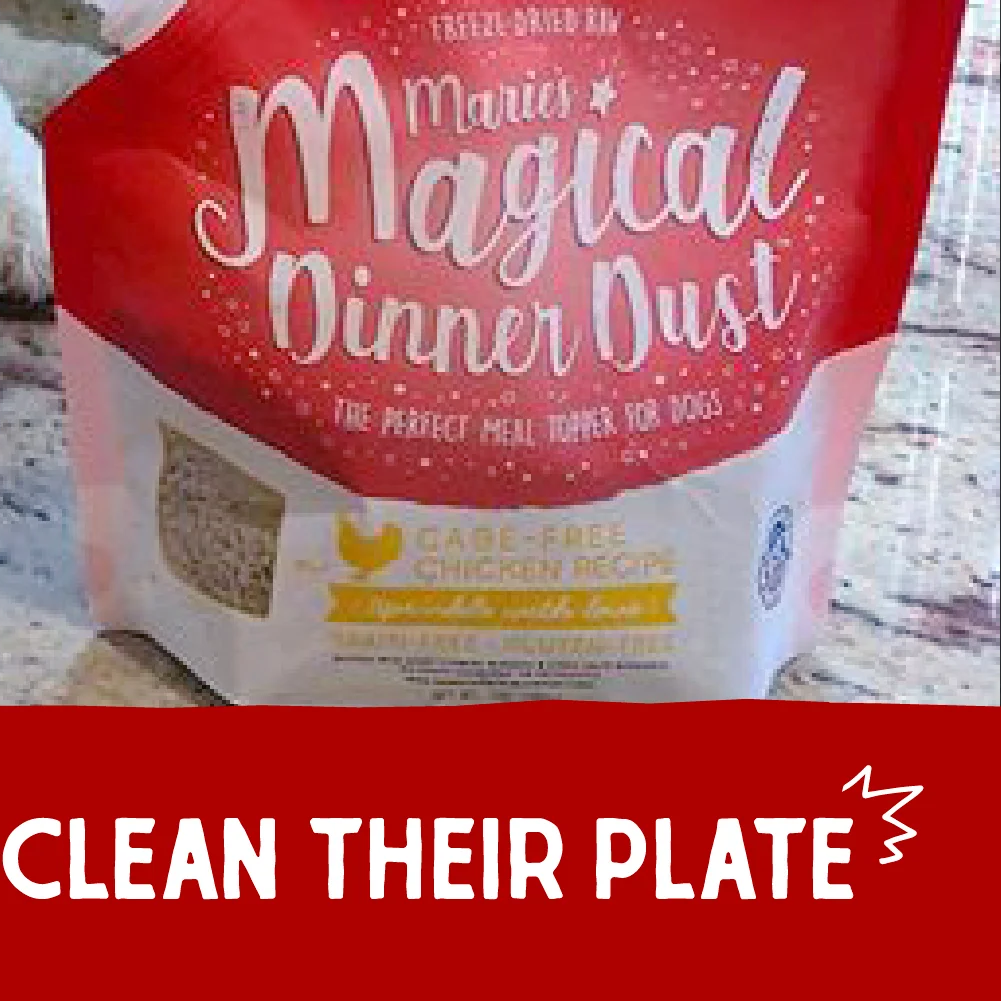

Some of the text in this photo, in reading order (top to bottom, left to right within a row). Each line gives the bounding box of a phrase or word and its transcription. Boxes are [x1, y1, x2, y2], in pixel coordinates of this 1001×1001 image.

[193, 49, 809, 289] Magical
[267, 240, 802, 379] Dinner Dust
[334, 388, 724, 447] THE PERFECT MEAL TOPPER FOR DOGS
[413, 548, 678, 581] CHICKEN RECIPE
